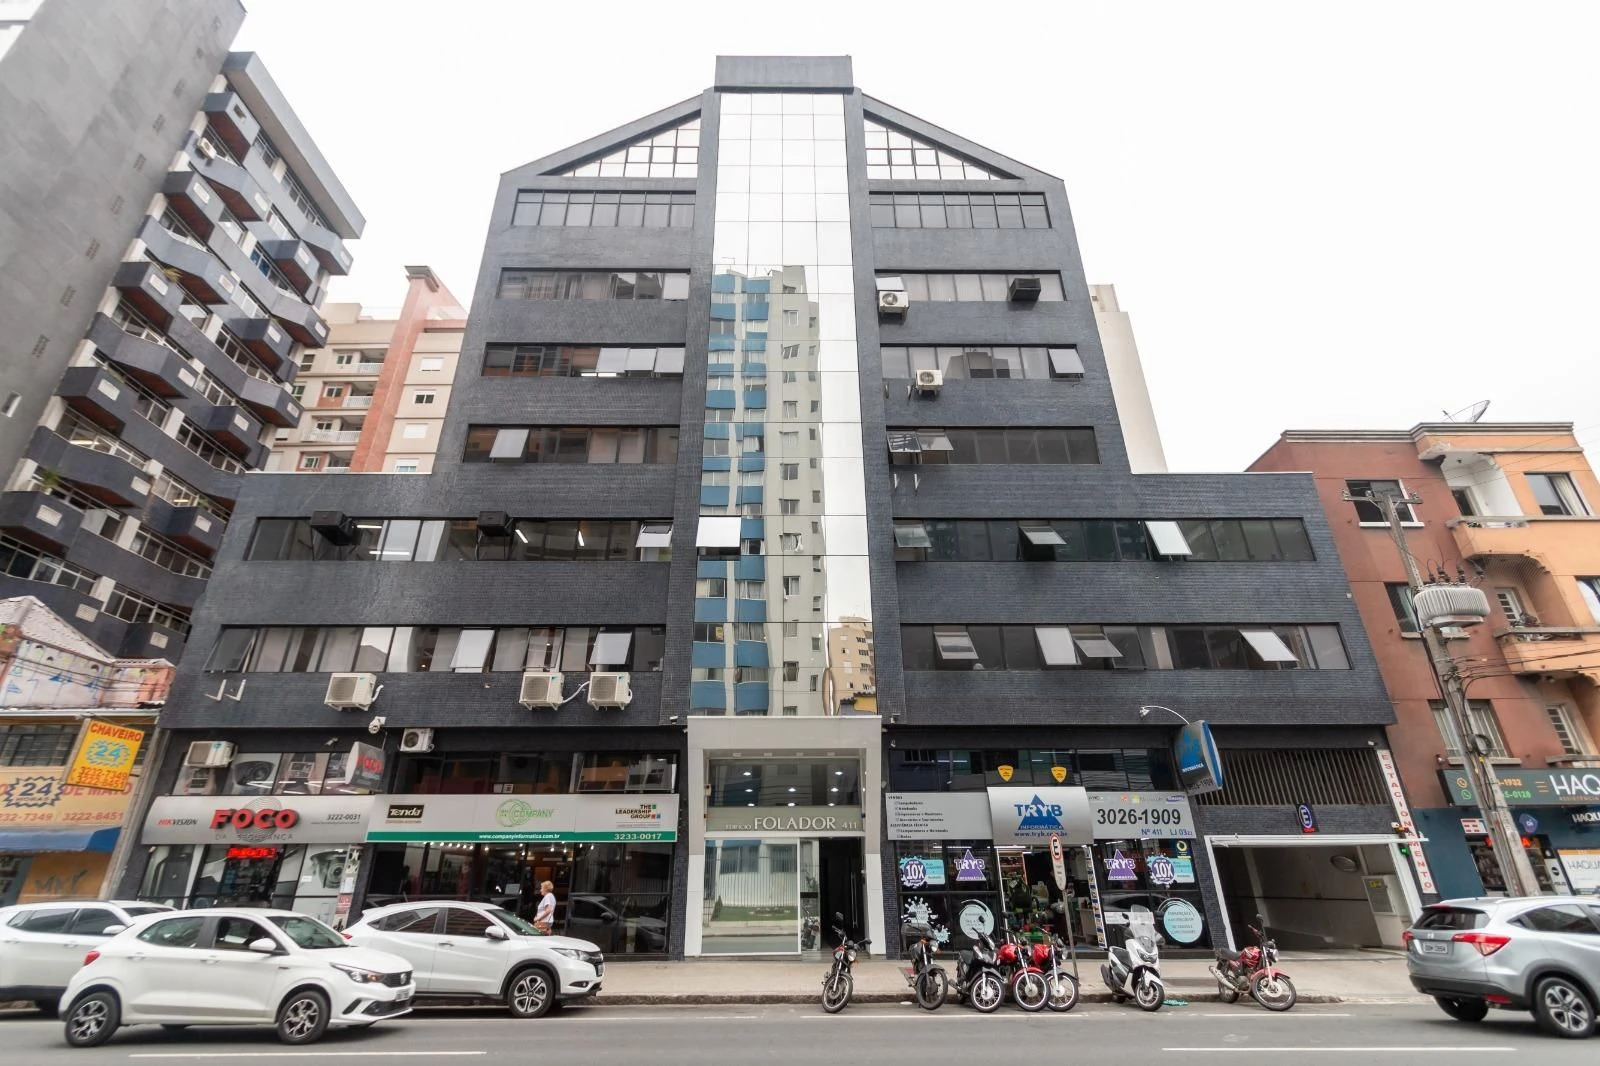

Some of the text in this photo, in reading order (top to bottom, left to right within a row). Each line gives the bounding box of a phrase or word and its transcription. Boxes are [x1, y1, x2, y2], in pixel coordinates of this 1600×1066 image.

[90, 723, 142, 742] CHAVEIRO
[96, 744, 121, 759] 24
[19, 782, 53, 797] 24
[513, 809, 555, 818] COMPANY
[1014, 804, 1063, 817] TRYB
[1097, 809, 1181, 825] 3026-1909
[158, 818, 198, 826] HIKVISION
[211, 808, 297, 830] FOCO
[754, 816, 836, 830] FOLADOR
[1053, 839, 1060, 856] E
[906, 864, 925, 880] 10X
[954, 859, 985, 870] TRYB
[1104, 859, 1136, 870] TRYB
[1154, 862, 1174, 878] 10X
